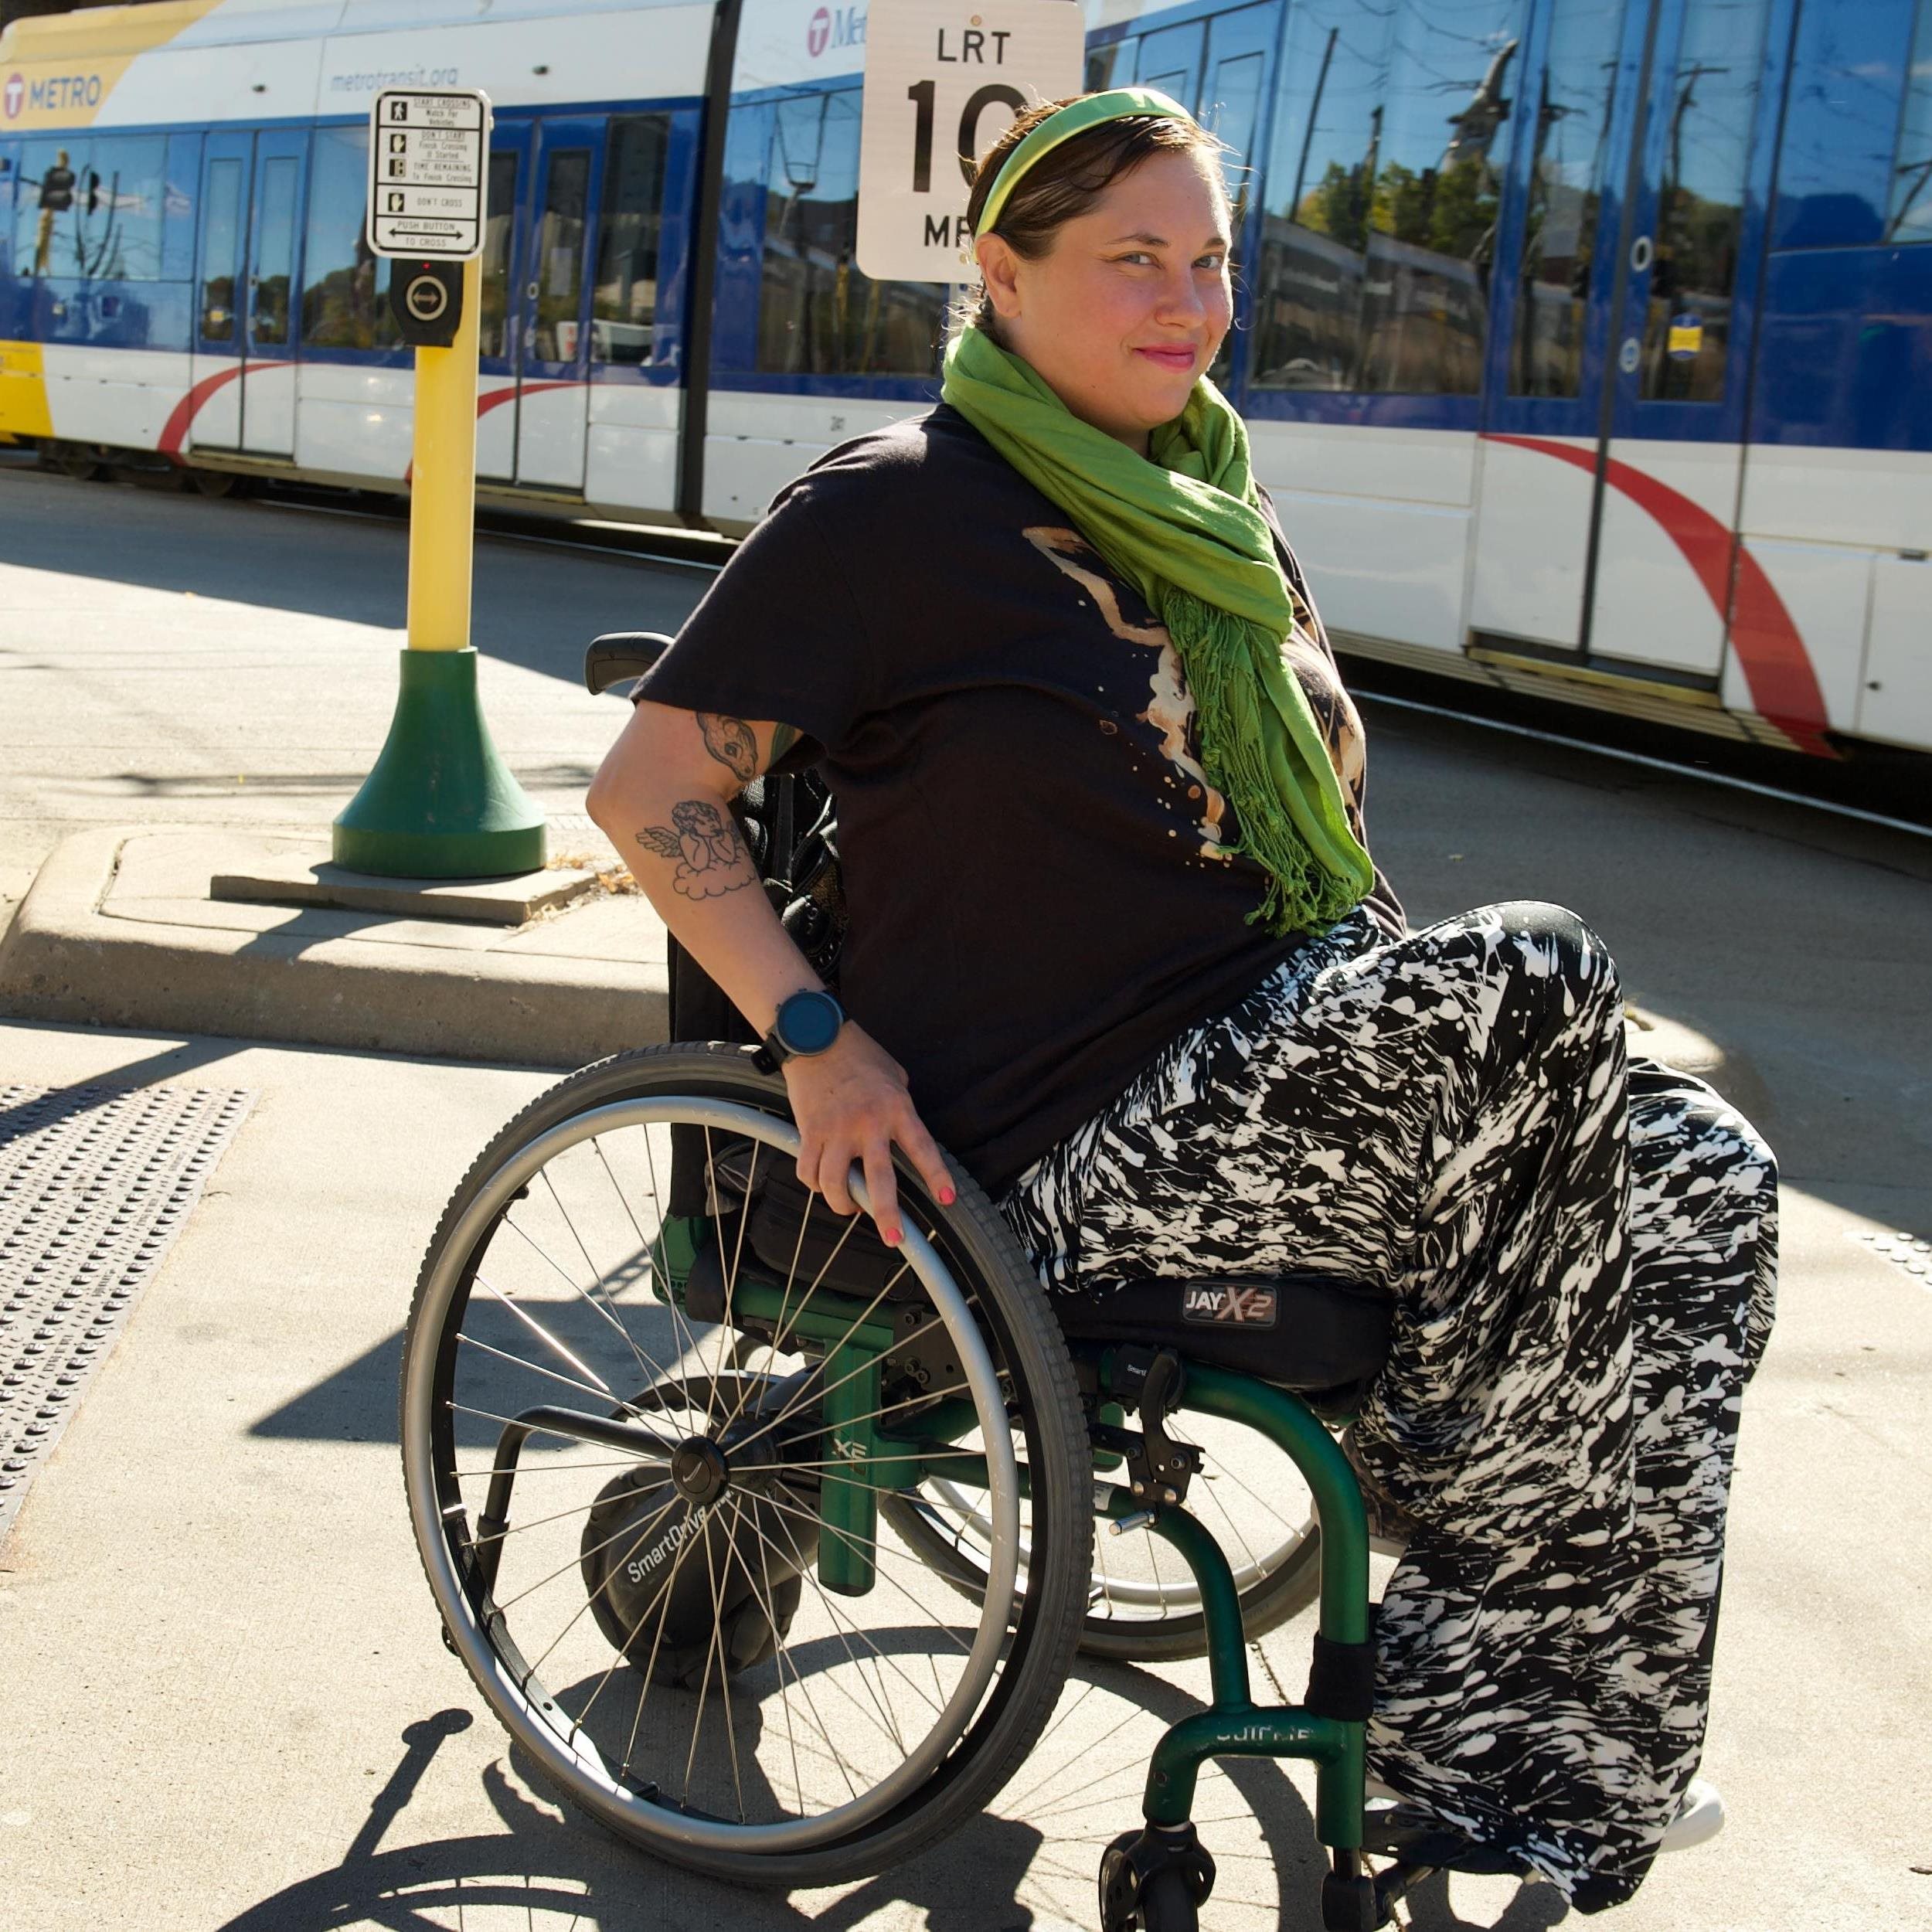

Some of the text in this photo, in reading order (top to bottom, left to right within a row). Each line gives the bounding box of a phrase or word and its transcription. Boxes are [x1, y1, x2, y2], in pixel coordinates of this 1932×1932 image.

[832, 6, 867, 49] Met
[937, 28, 1011, 65] LRT
[29, 74, 101, 109] METRO
[907, 80, 1029, 192] 10
[441, 198, 463, 208] CROSS
[396, 220, 455, 231] PUSH BUTTON
[406, 237, 447, 247] TO CROSS
[924, 214, 969, 248] MP
[1185, 1290, 1226, 1311] JAY
[628, 1505, 707, 1583] SmartDrive
